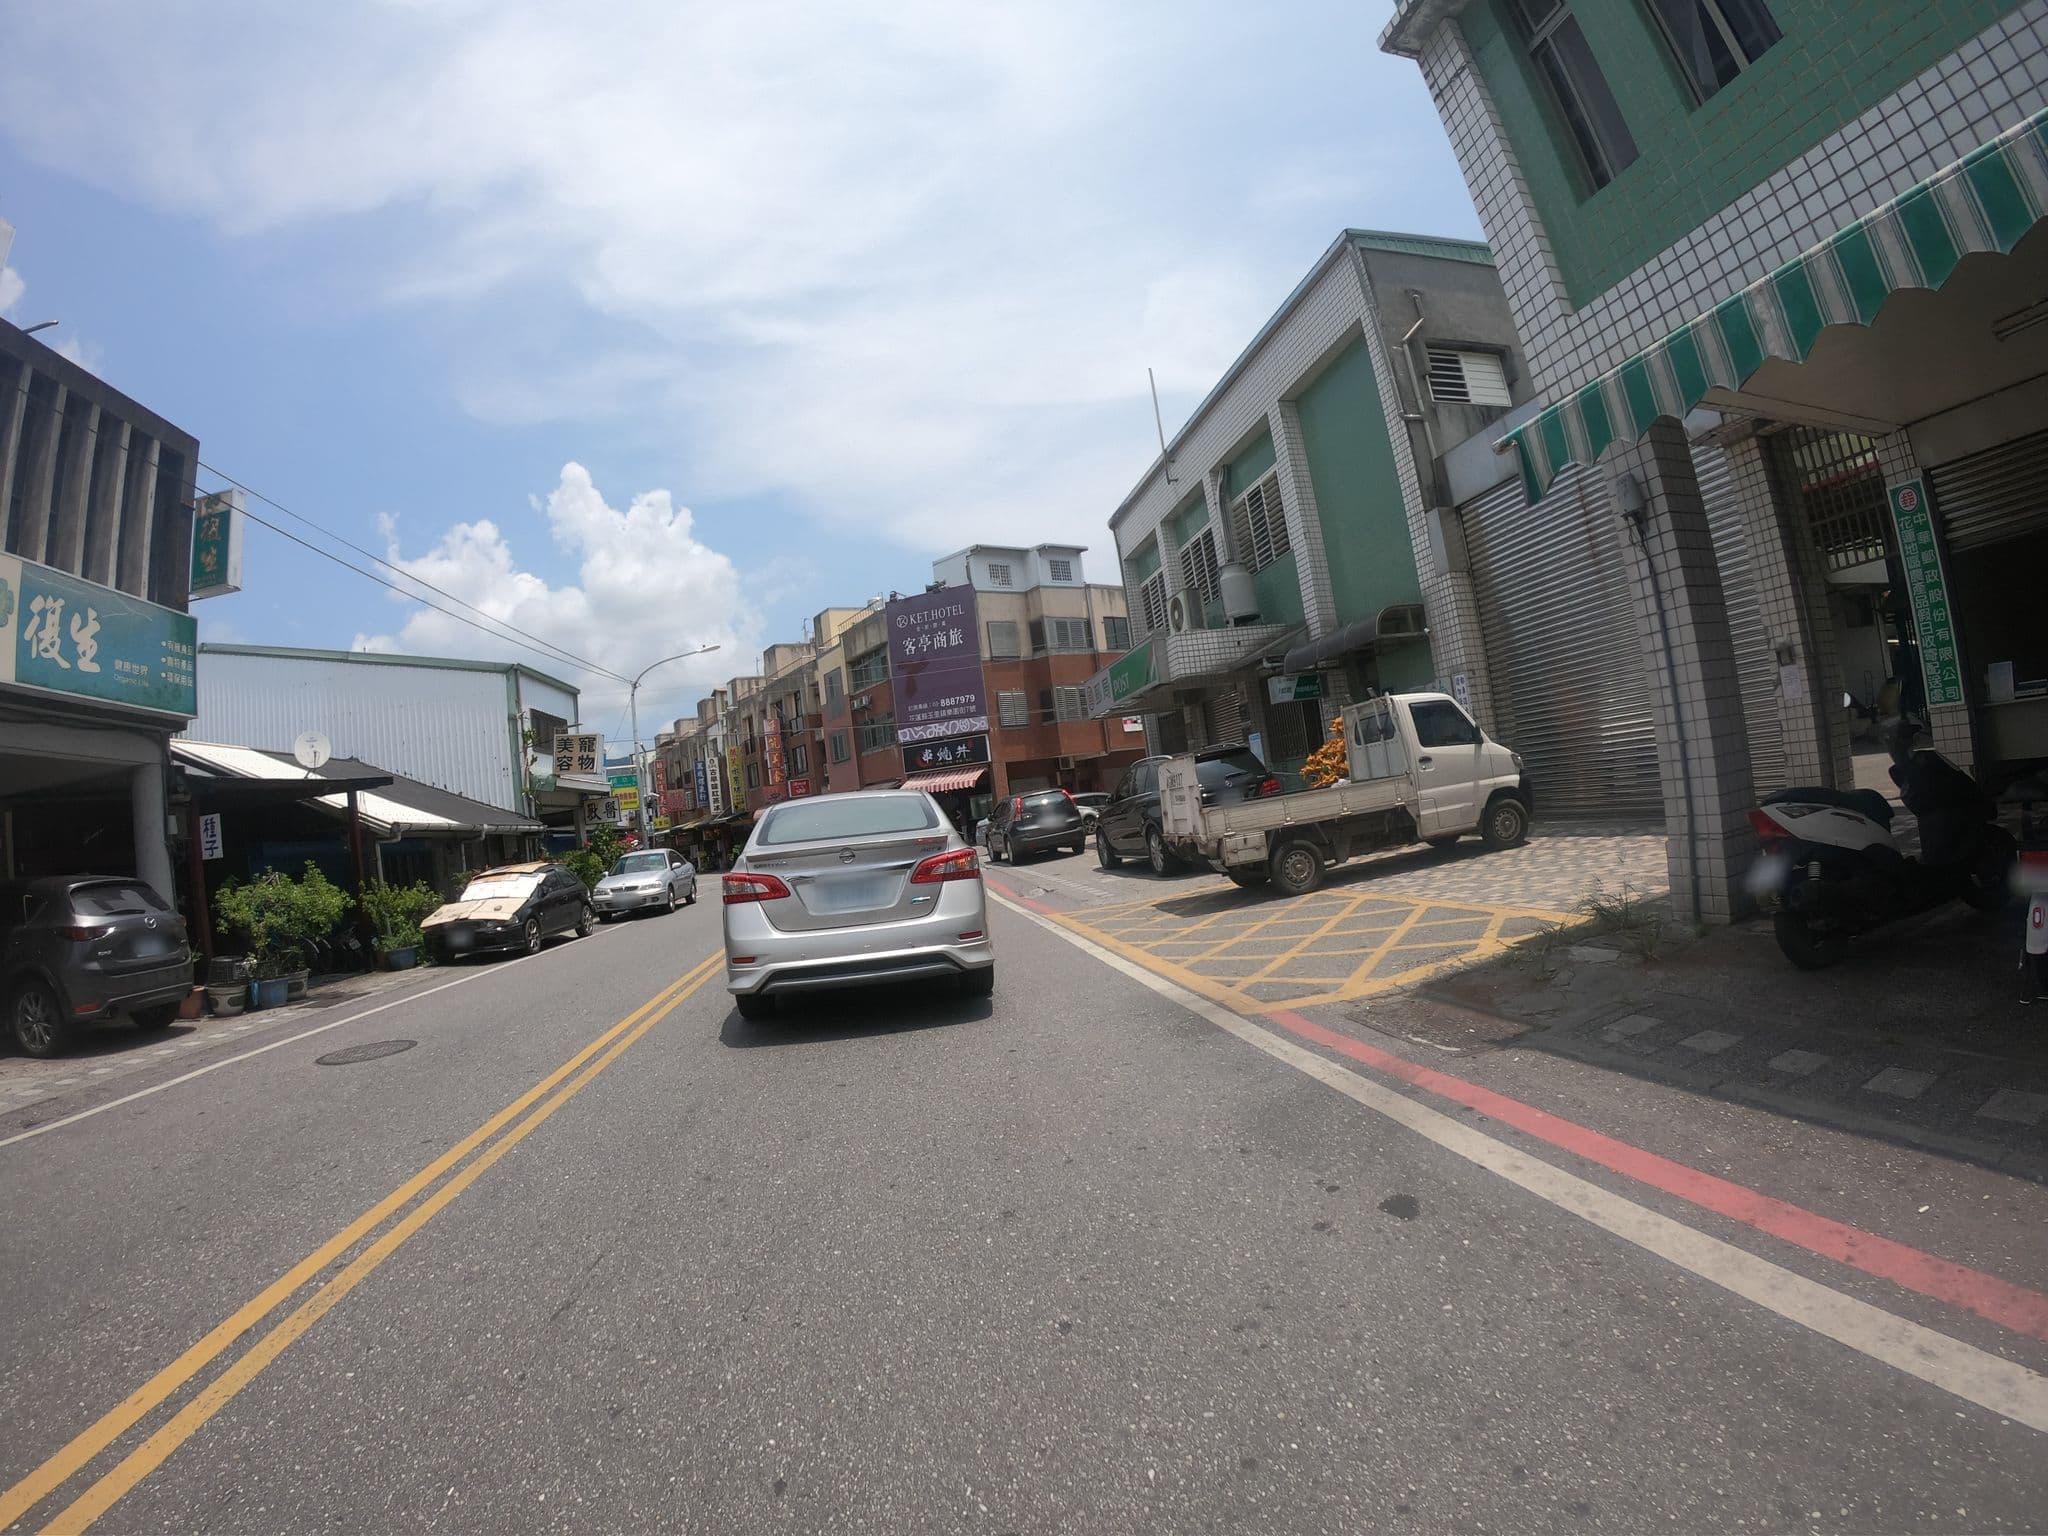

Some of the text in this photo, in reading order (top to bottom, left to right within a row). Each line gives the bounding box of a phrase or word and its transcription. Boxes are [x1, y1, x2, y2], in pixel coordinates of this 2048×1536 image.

[1913, 513, 1960, 700] 中華郵政股份有限公司
[902, 627, 964, 656] 客亭商旅
[940, 694, 976, 707] 8887979
[1113, 672, 1130, 696] POST
[556, 737, 575, 771] 美容
[577, 736, 596, 771] 寵物
[203, 816, 219, 858] 種子
